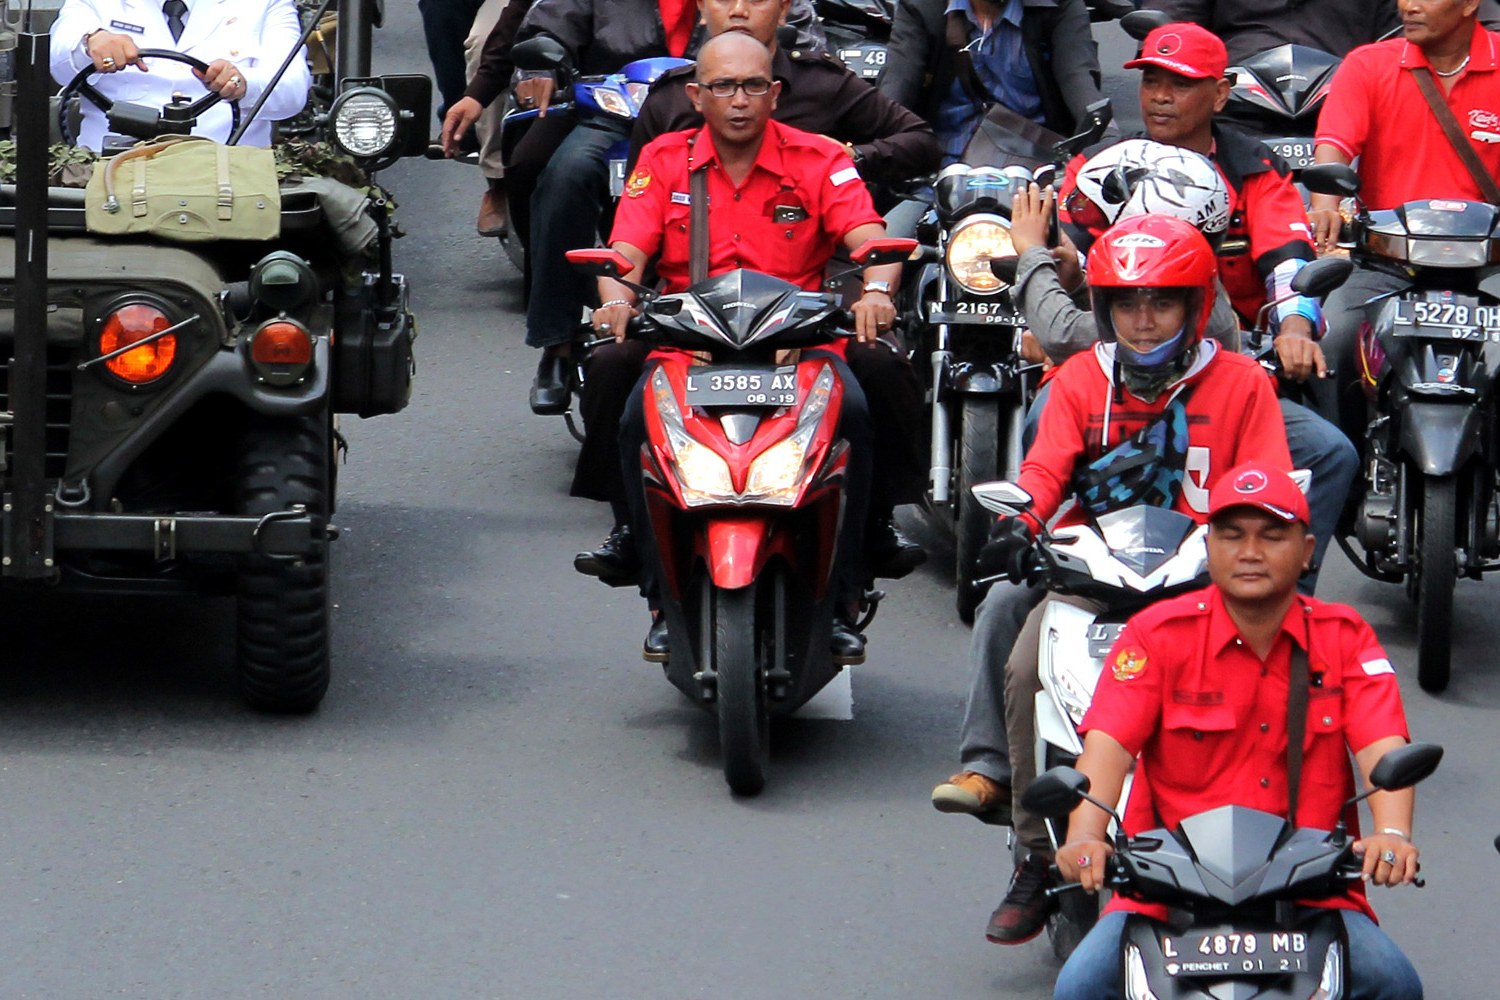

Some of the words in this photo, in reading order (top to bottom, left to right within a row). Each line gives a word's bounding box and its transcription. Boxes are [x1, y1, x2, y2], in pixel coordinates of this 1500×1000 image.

[866, 51, 887, 66] 48
[1117, 234, 1158, 246] INK
[721, 301, 758, 311] HONDA
[931, 302, 943, 314] N
[957, 302, 1002, 315] 2167
[1395, 302, 1409, 322] L
[1414, 302, 1469, 326] 5278
[687, 376, 699, 392] L
[711, 375, 762, 392] 3585
[771, 375, 796, 390] AX
[1093, 625, 1108, 642] L
[1164, 938, 1179, 959] L
[1198, 935, 1258, 956] 4879
[1272, 934, 1306, 953] MB
